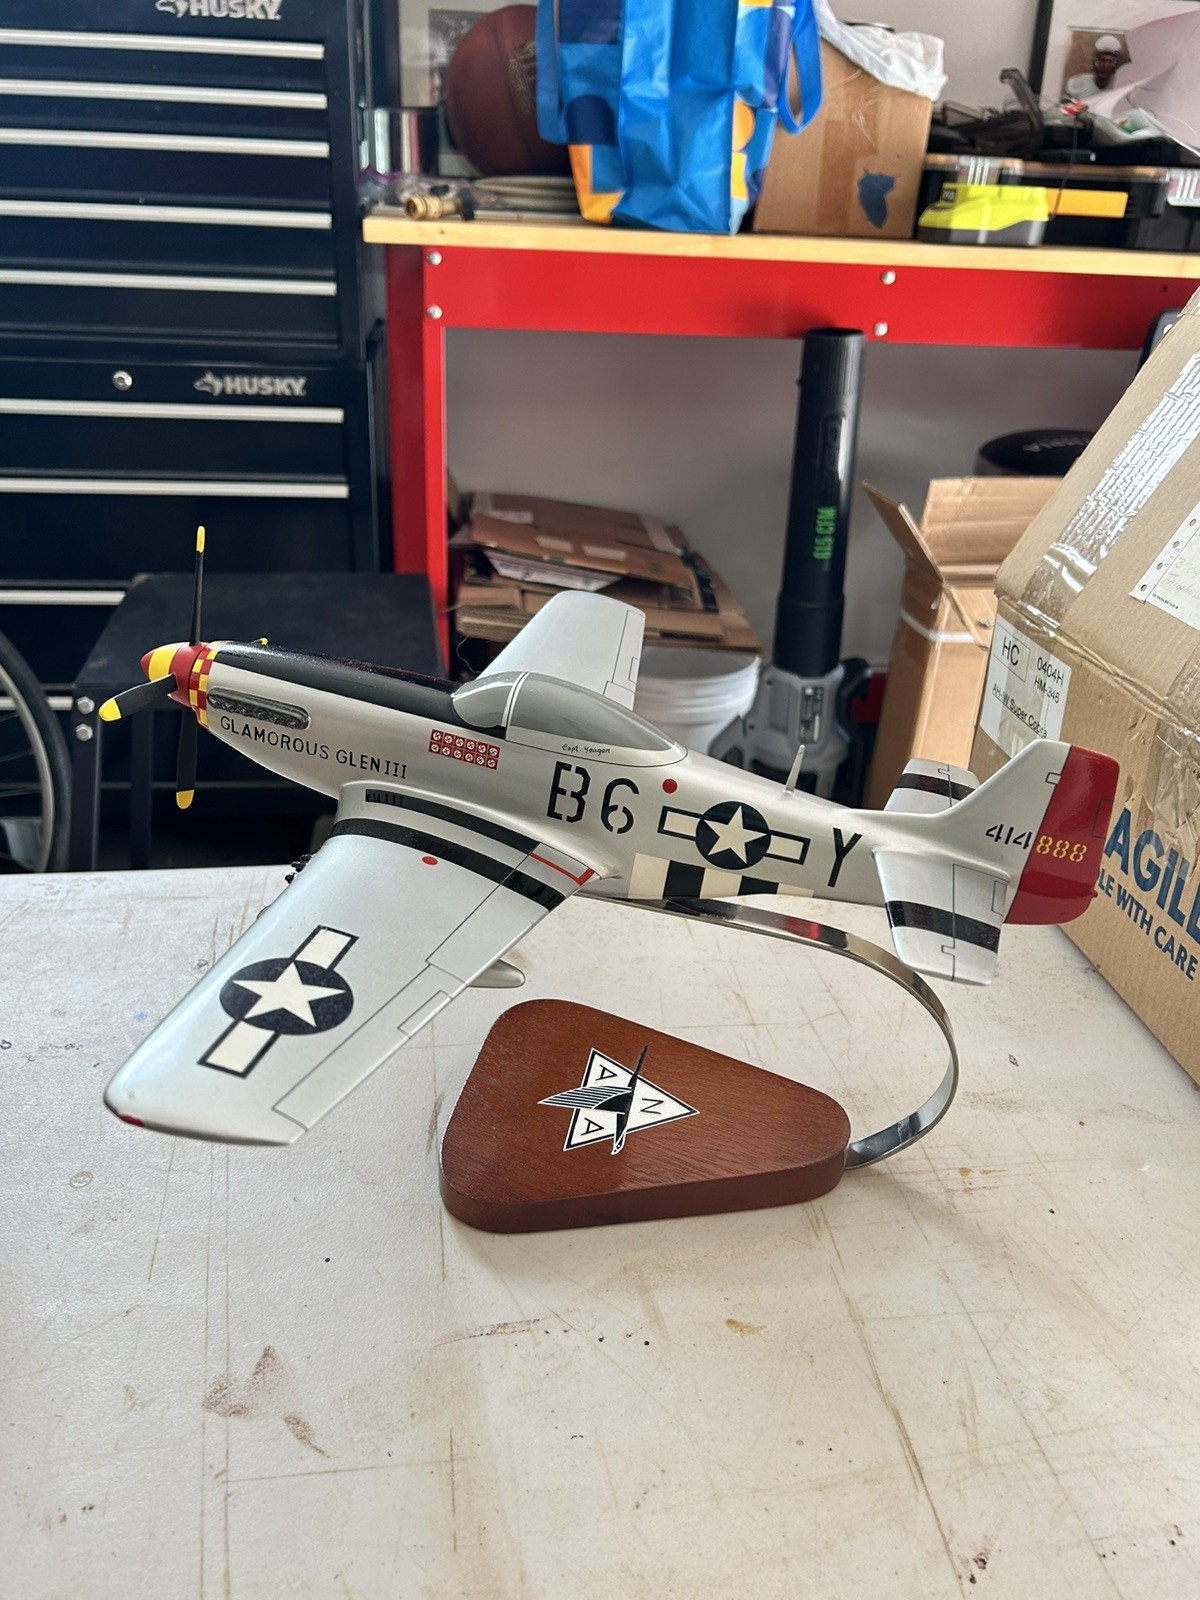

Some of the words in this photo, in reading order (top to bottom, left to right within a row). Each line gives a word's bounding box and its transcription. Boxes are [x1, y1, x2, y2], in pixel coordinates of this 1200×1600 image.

[189, 0, 280, 20] HUSKY
[223, 375, 307, 397] HUSKY
[1001, 636, 1020, 666] HC
[1036, 657, 1064, 686] 0404H
[1033, 675, 1060, 704] HM-346
[220, 715, 330, 760] GLAMOROUS
[827, 827, 863, 888] Y
[1116, 883, 1154, 937] WITH
[1154, 925, 1199, 982] CARE
